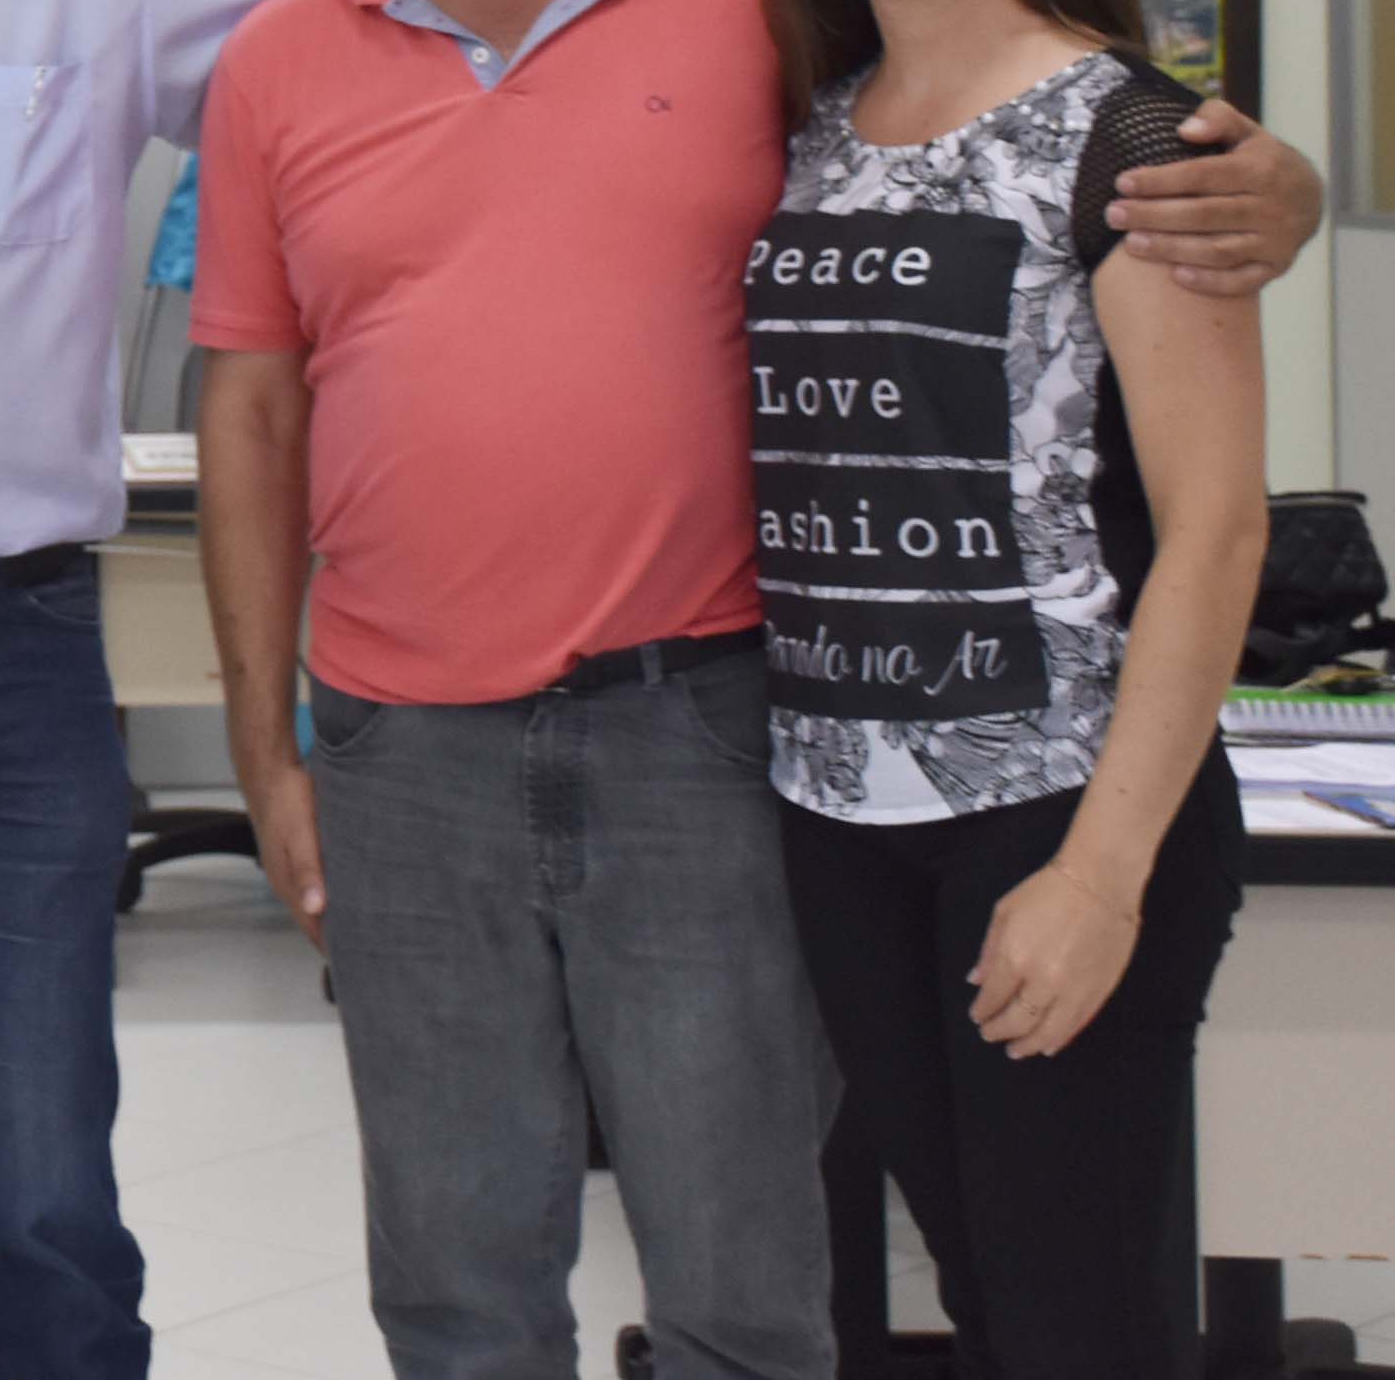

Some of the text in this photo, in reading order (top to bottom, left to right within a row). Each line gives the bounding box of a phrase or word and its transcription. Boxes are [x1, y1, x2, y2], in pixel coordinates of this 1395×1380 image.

[743, 238, 932, 286] Peace
[752, 366, 902, 419] Love
[759, 498, 1002, 558] ashion
